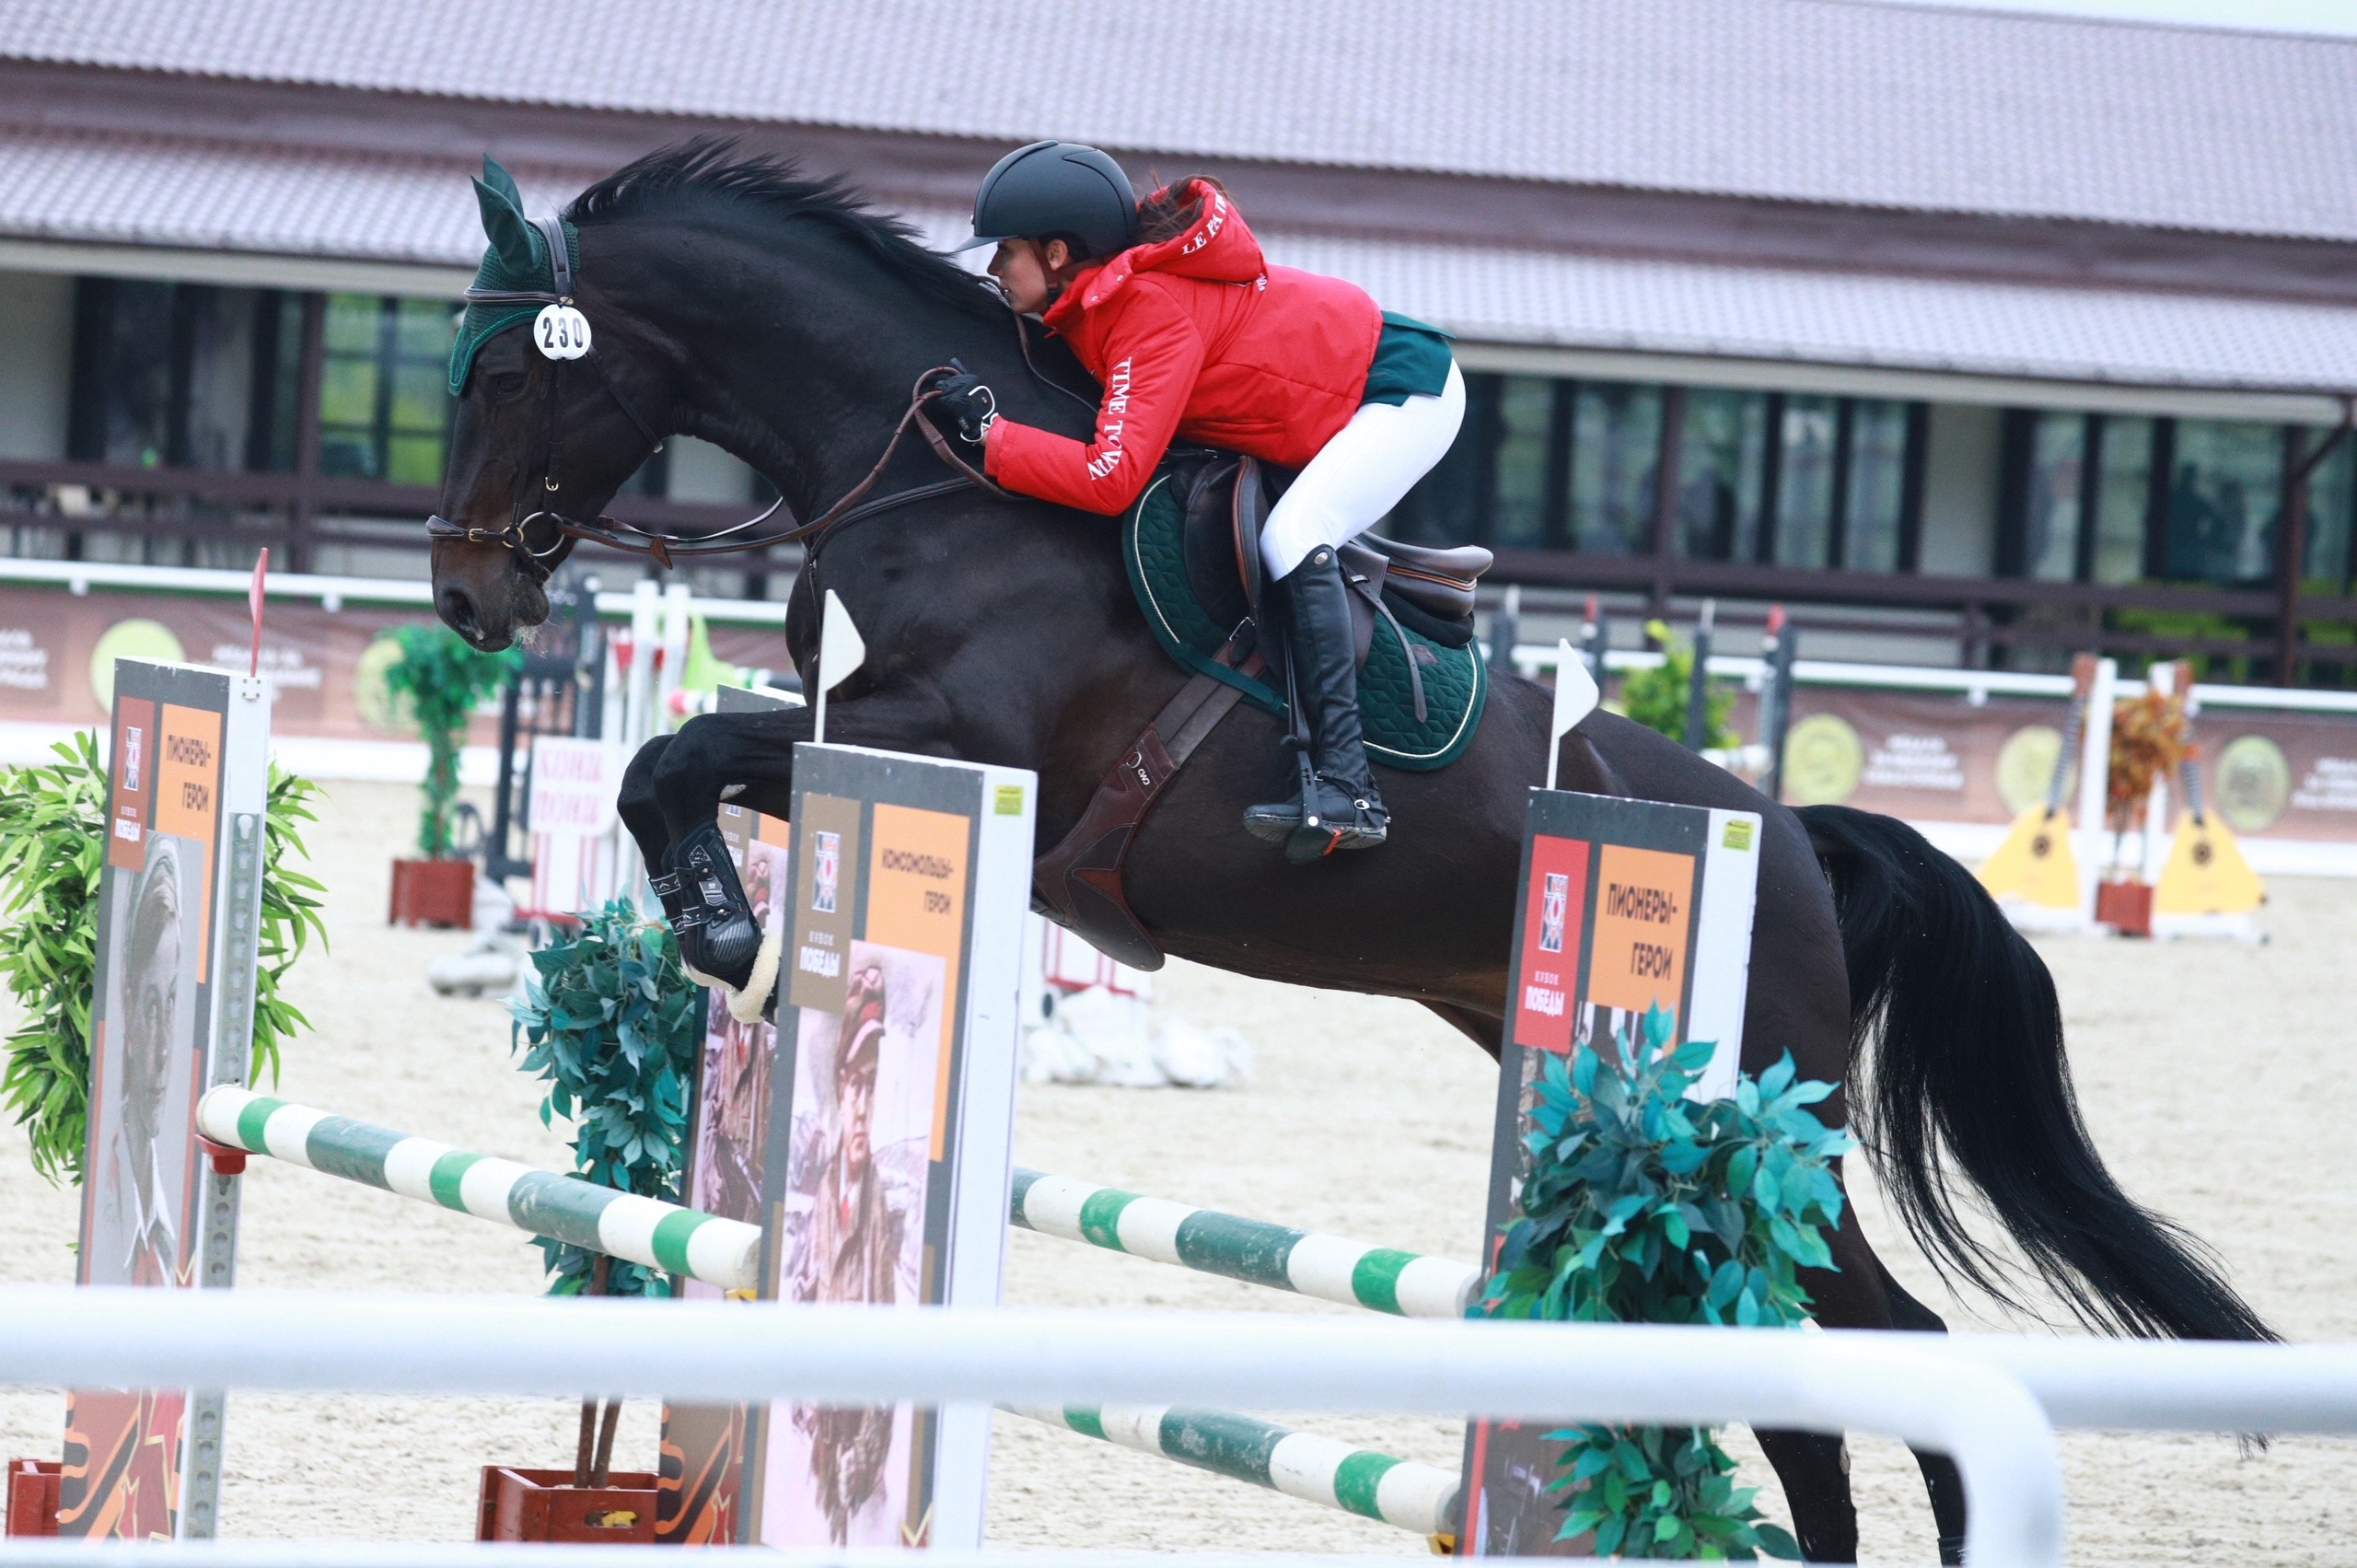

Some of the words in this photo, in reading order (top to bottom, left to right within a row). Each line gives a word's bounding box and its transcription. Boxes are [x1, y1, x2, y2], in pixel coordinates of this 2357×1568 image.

[1181, 231, 1207, 255] LE
[542, 317, 584, 348] 230
[1108, 356, 1132, 414] TIME
[1138, 768, 1150, 784] CWD
[182, 782, 209, 812] ГЕРОИ
[923, 890, 951, 914] ГЕРОИ
[1607, 883, 1678, 923] ПИОНЕРЫ-
[799, 946, 841, 978] ПОБЕДЫ
[1631, 942, 1673, 981] ГЕРОИ
[1525, 986, 1565, 1016] ПОБЕДЫ
